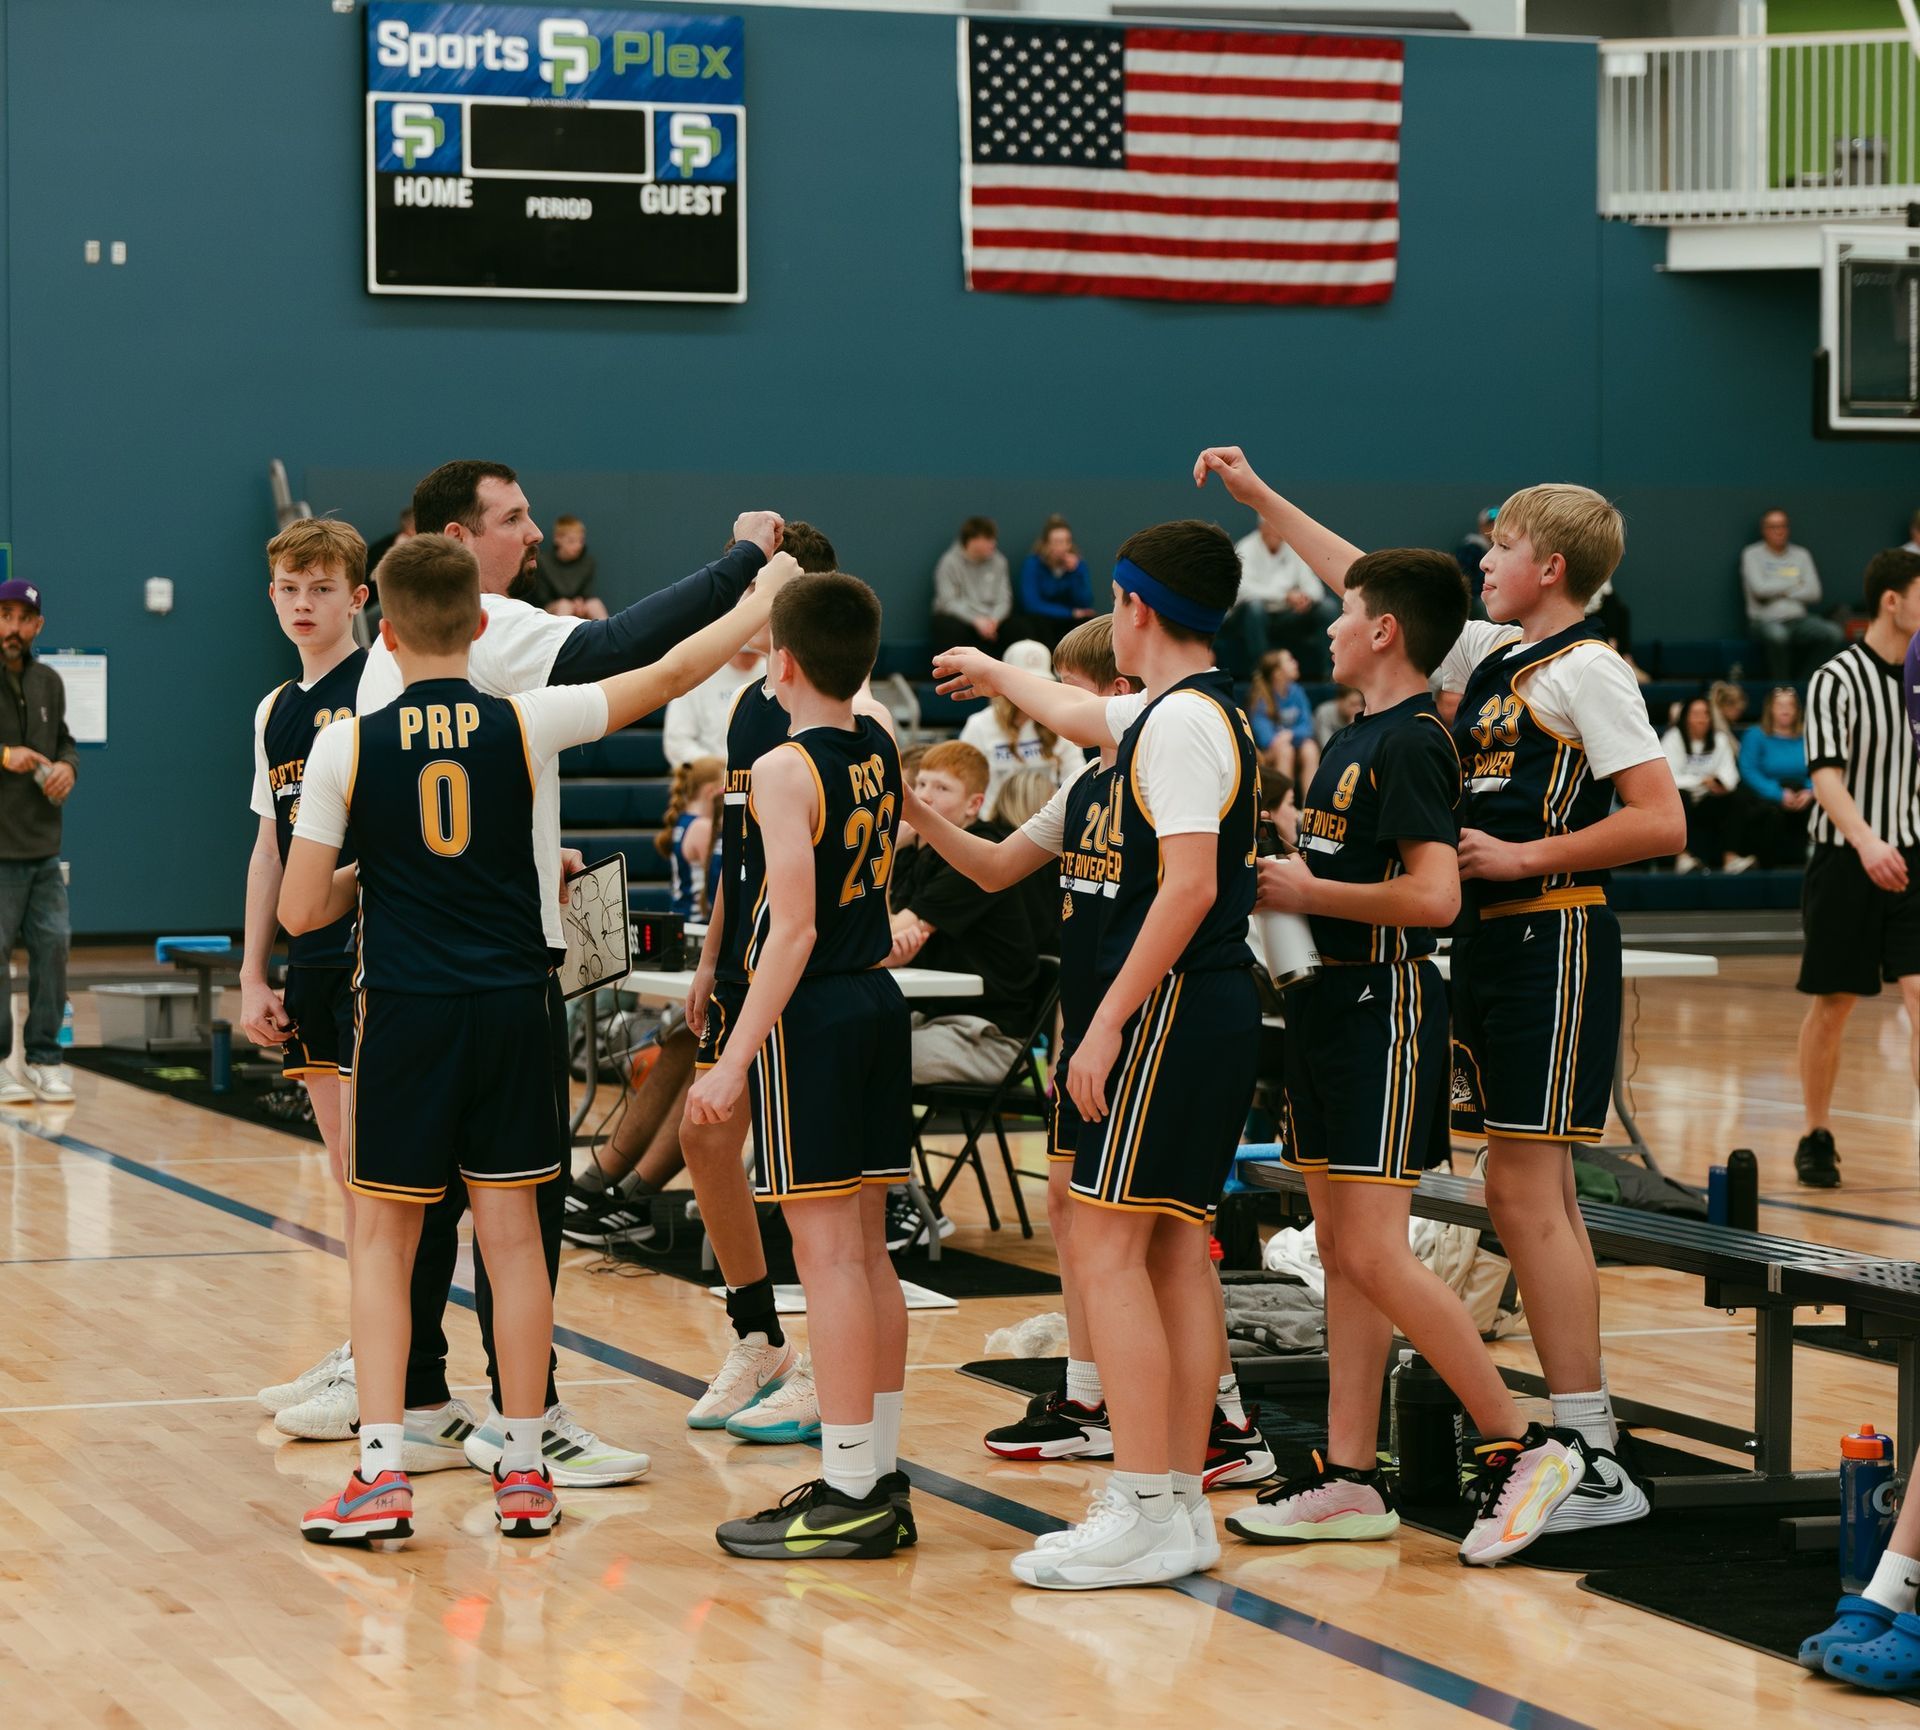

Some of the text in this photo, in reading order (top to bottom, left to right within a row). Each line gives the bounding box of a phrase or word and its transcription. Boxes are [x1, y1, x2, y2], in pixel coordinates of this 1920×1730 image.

[377, 20, 530, 77] Sports
[613, 30, 732, 79] Plex
[394, 177, 474, 208] HOME
[526, 196, 594, 220] PERIOD
[640, 184, 727, 216] GUEST
[400, 703, 480, 750] PRP
[1470, 694, 1525, 749] 33
[1333, 762, 1361, 811] 9
[1472, 751, 1515, 778] RIVER
[418, 759, 471, 858] 0
[1079, 802, 1109, 853] 20
[1312, 810, 1348, 842] RIVER
[839, 791, 895, 907] 23
[1074, 853, 1107, 882] RIVER
